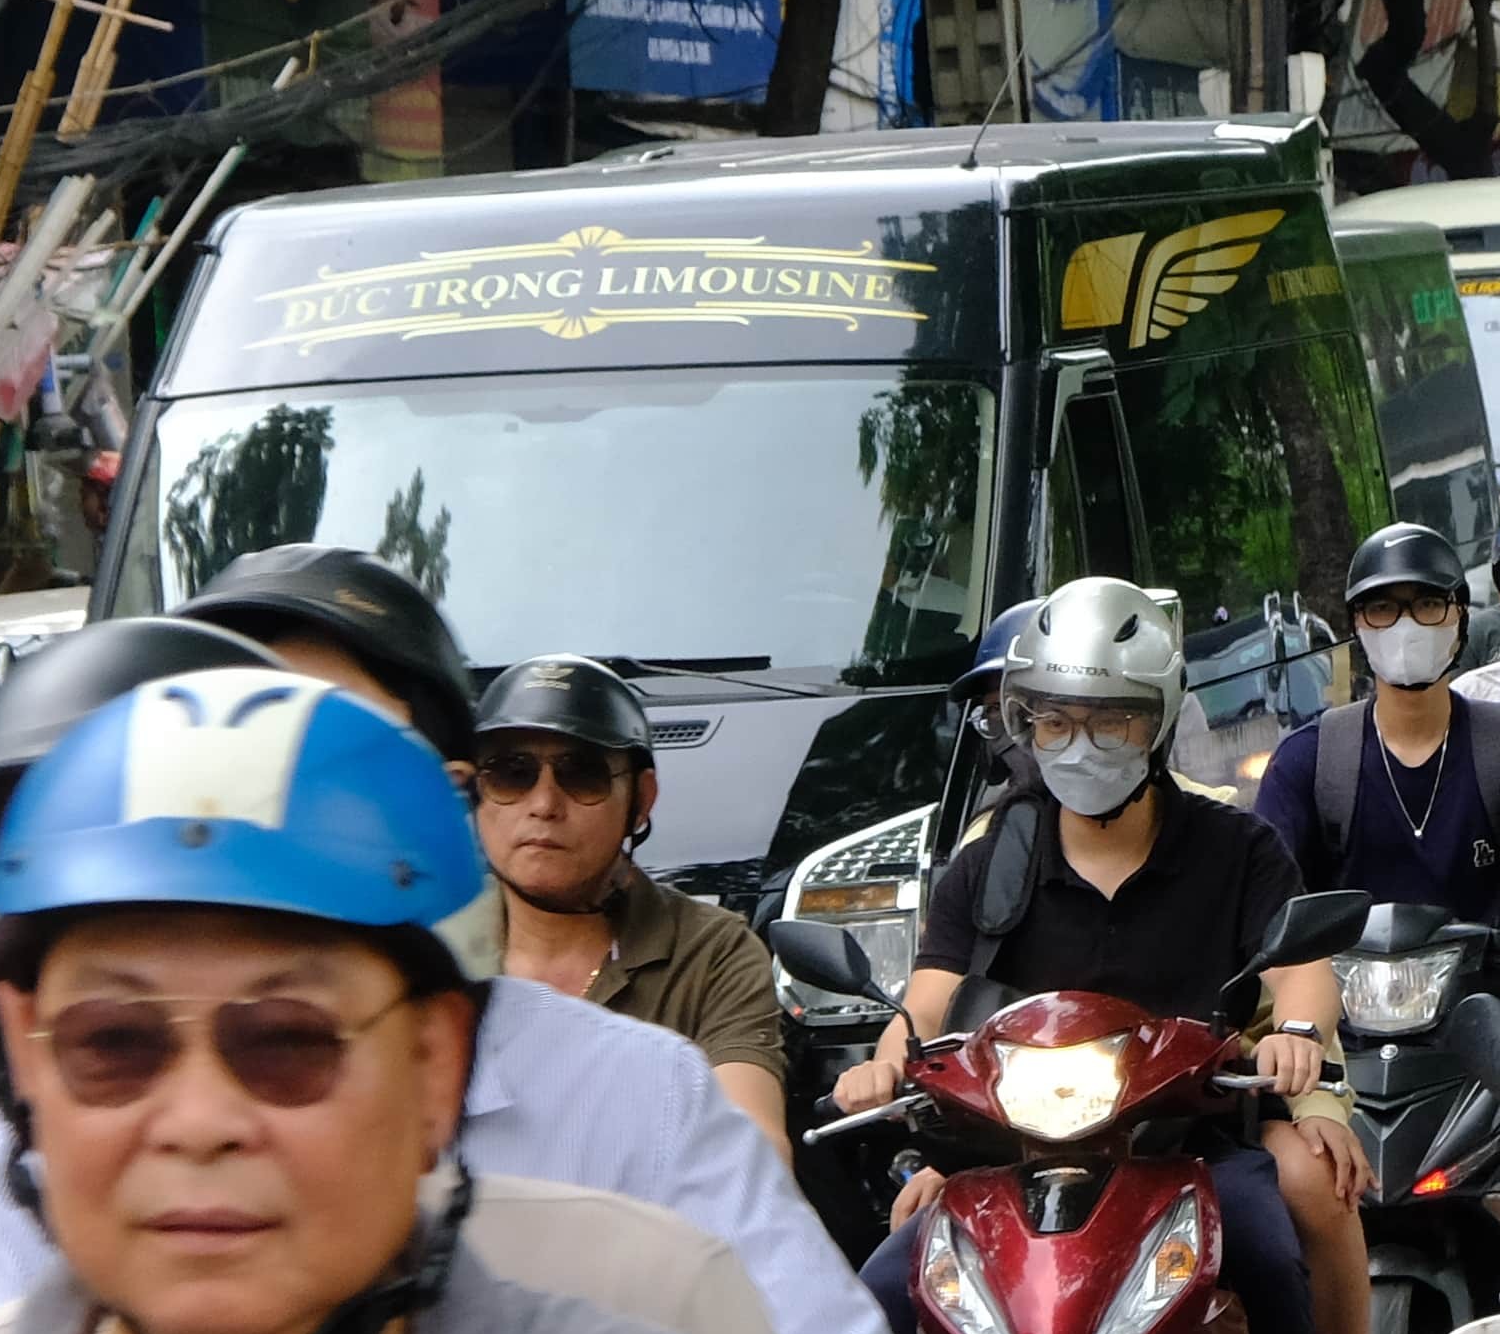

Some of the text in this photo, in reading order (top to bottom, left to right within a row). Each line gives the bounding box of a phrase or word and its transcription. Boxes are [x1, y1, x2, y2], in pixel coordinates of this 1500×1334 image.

[282, 265, 896, 329] ĐỨC TRỌNG LIMOUSINE
[1045, 662, 1111, 677] HONDA
